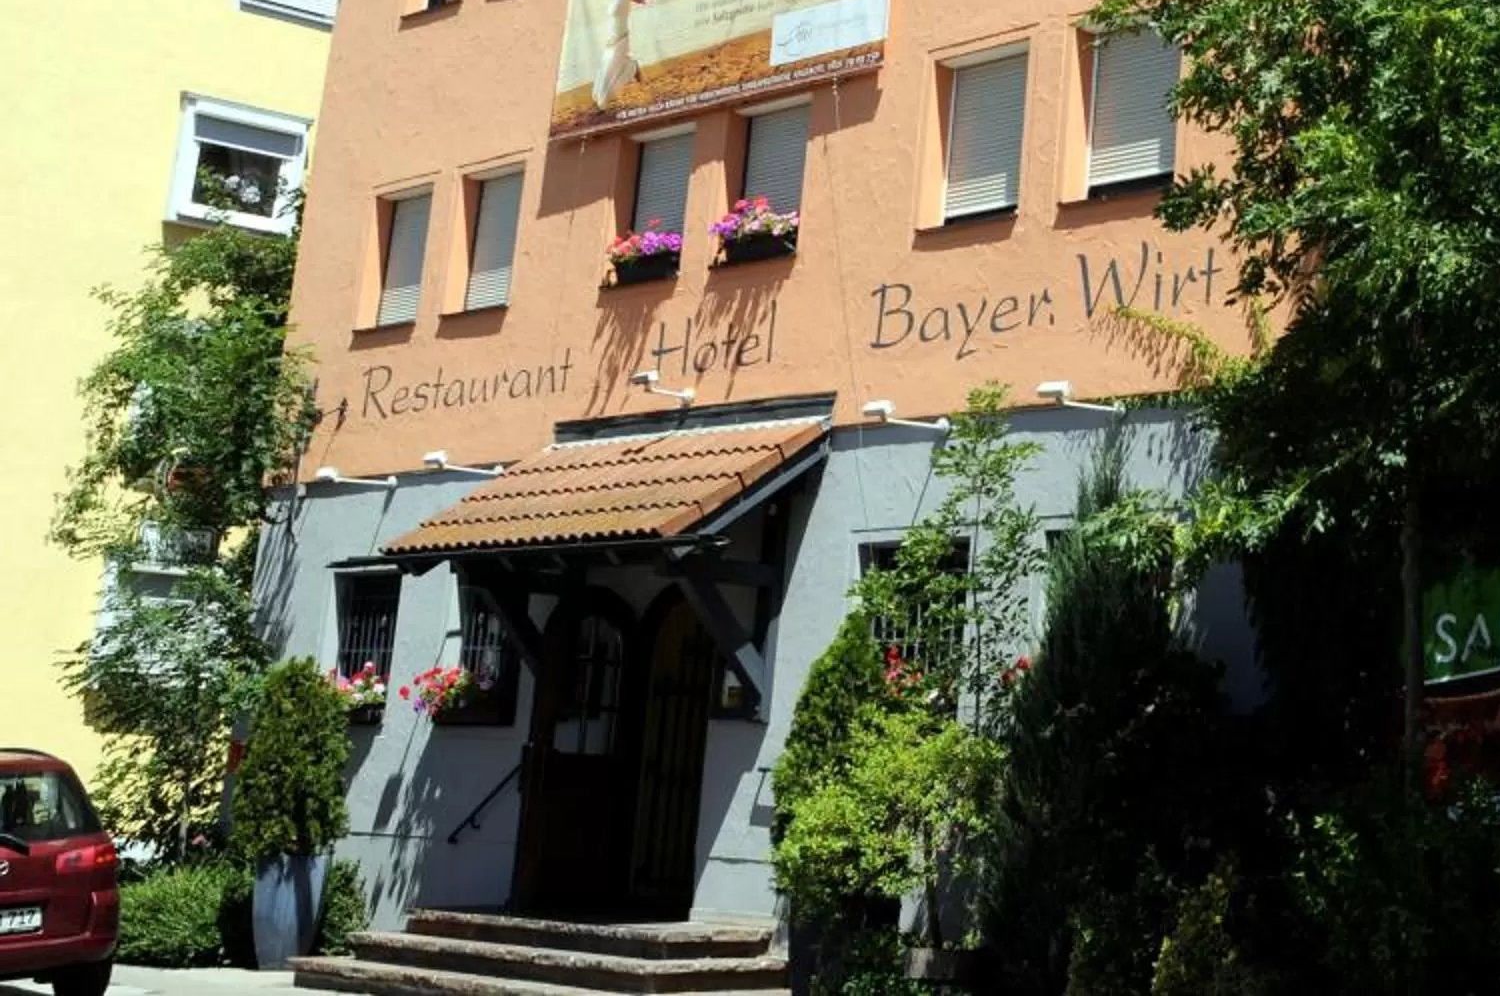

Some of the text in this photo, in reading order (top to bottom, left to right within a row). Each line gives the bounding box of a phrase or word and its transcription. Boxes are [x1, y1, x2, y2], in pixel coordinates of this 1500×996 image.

[361, 347, 575, 420] Restaurant
[651, 300, 777, 377] Hotel
[1077, 240, 1222, 319] Wirt
